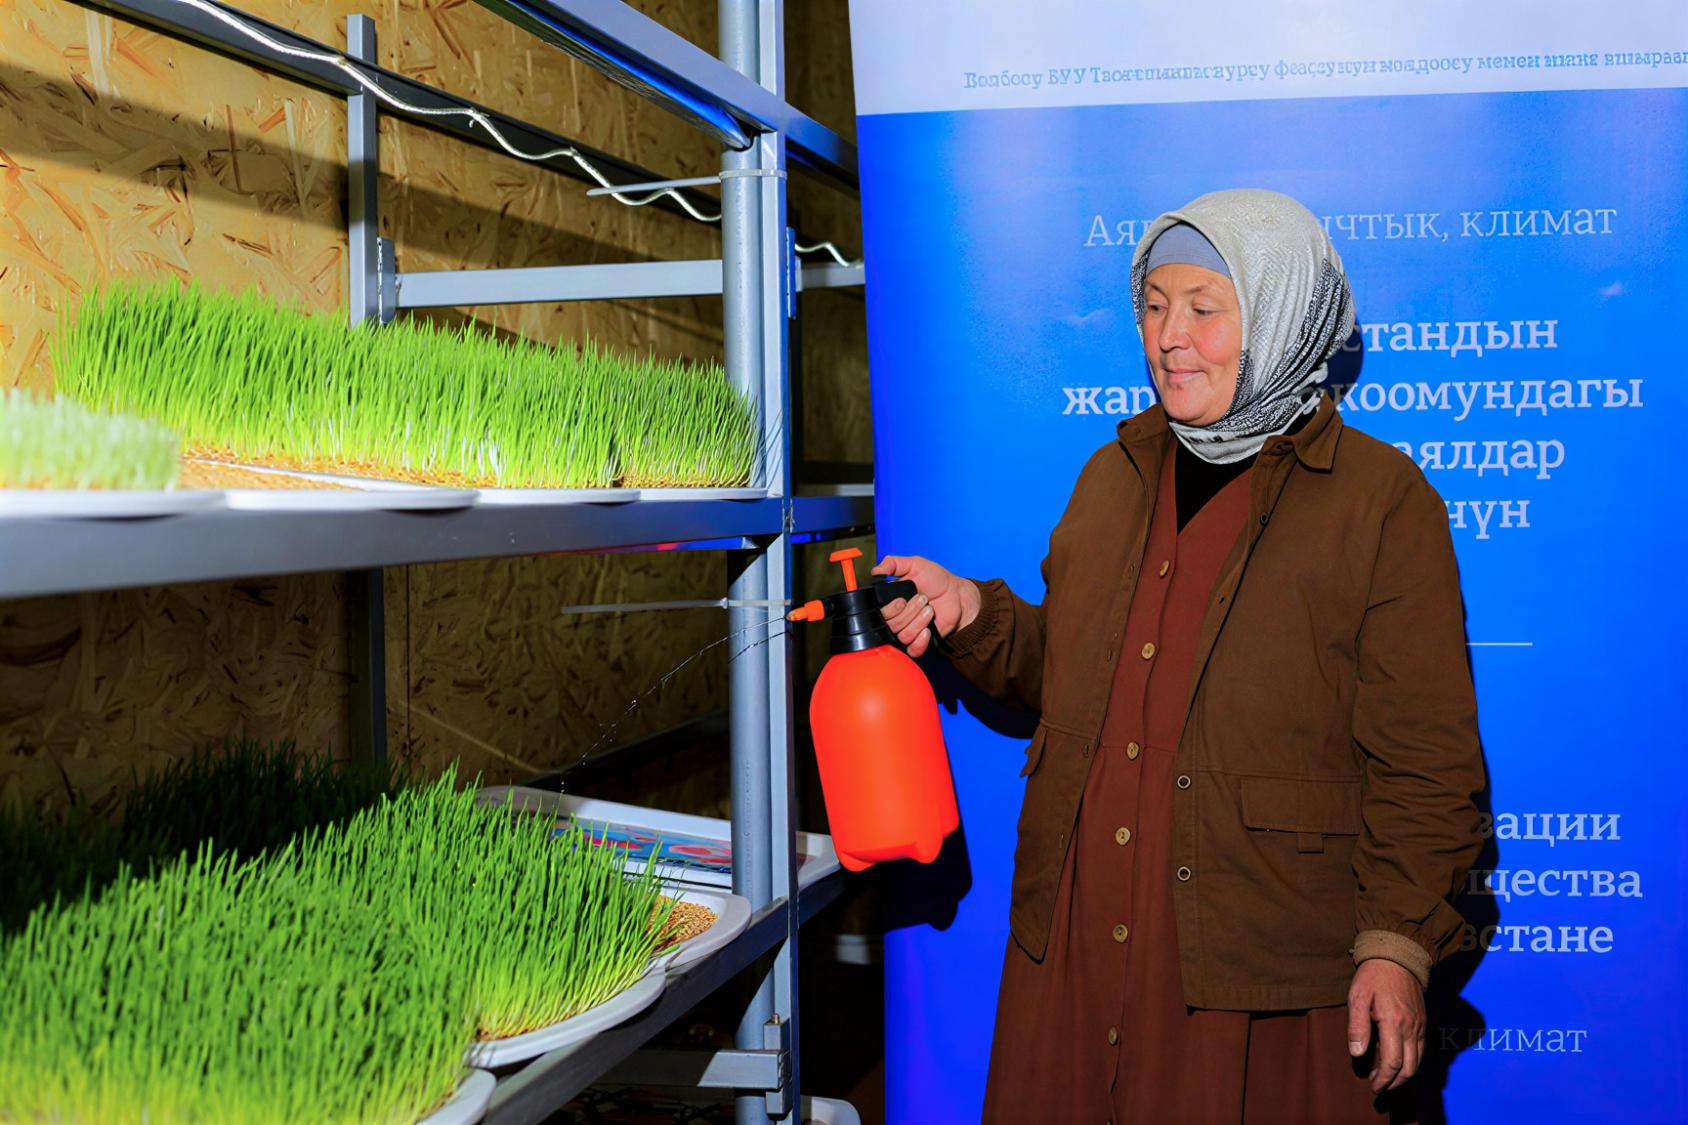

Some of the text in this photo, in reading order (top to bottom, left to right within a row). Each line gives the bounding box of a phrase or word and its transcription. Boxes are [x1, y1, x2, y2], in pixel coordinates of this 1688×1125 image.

[1459, 207, 1617, 238] климат
[1391, 439, 1566, 480] ялдар
[1439, 1027, 1588, 1053] климат
